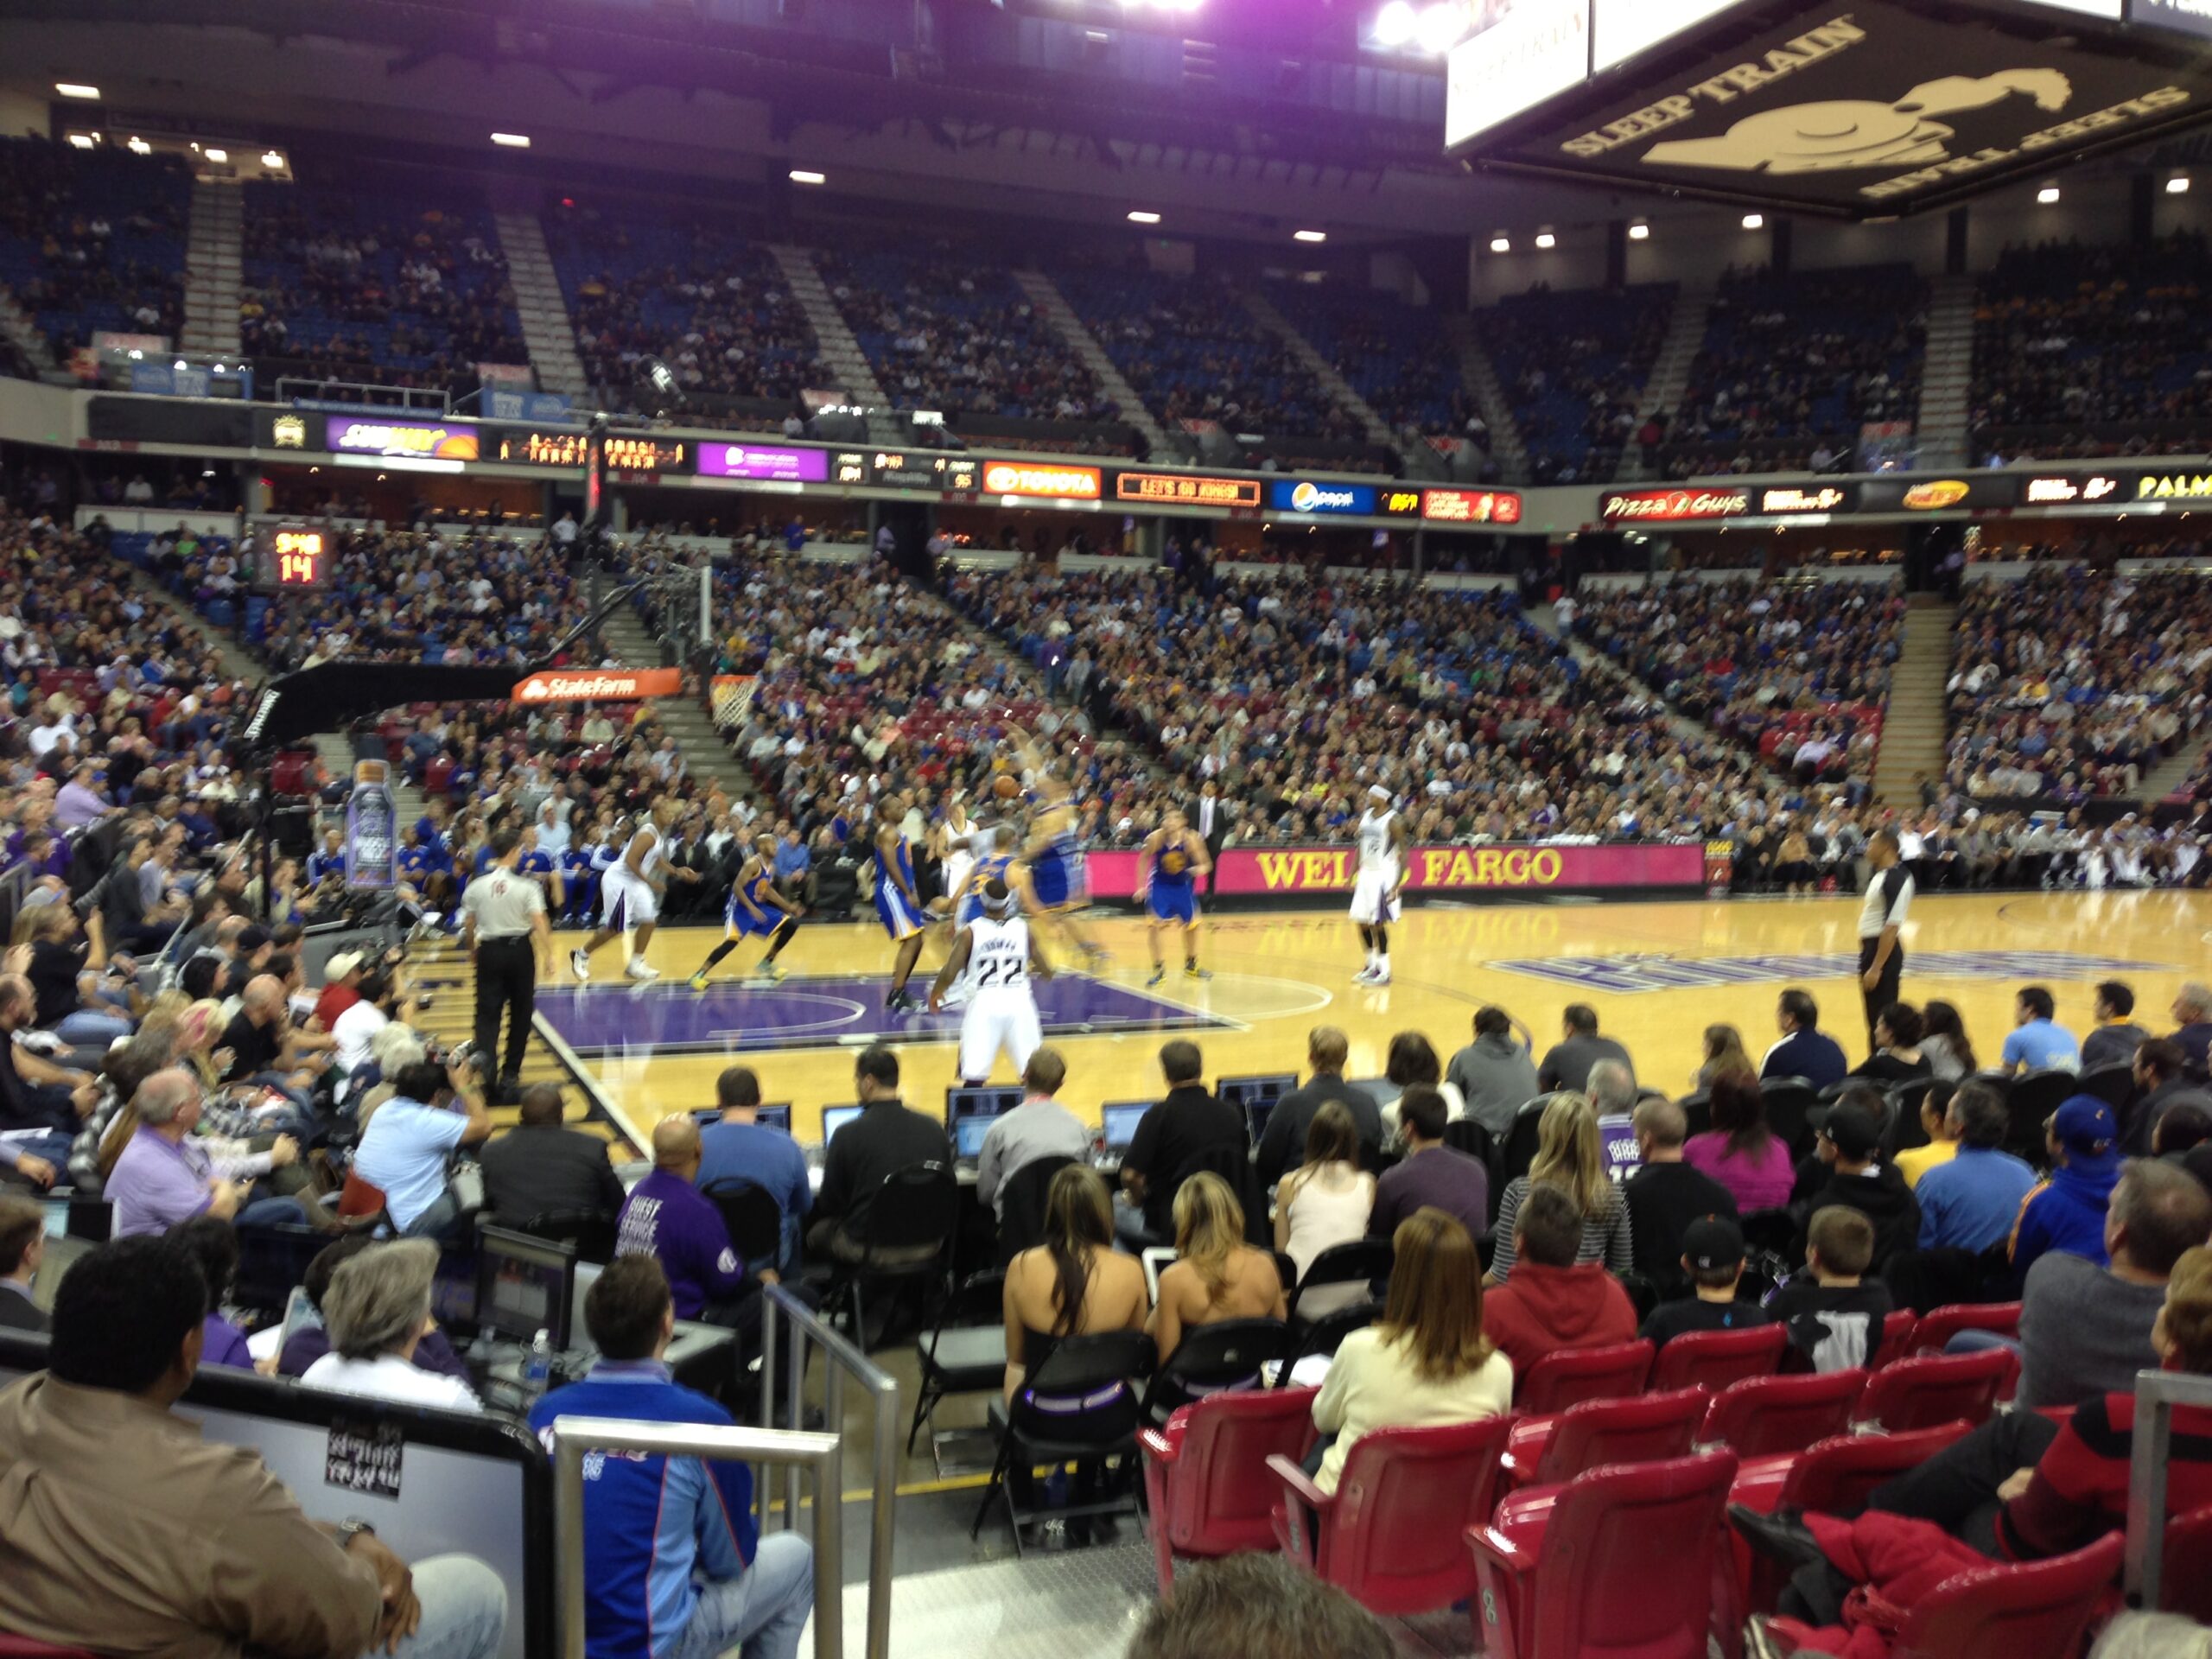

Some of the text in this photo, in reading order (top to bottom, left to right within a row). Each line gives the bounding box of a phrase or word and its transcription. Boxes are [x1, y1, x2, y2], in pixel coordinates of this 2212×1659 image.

[1560, 13, 1867, 158] SLEEP TRAIN
[1018, 469, 1096, 493] TOYOTA
[1140, 479, 1176, 496] LET'S
[1178, 480, 1197, 497] GO
[1314, 491, 1355, 508] pepsi
[1603, 496, 1669, 518] Pizza
[1690, 493, 1748, 516] Guys
[281, 555, 313, 582] 14
[1255, 849, 1563, 889] WEL FARGO
[976, 957, 1023, 988] 22
